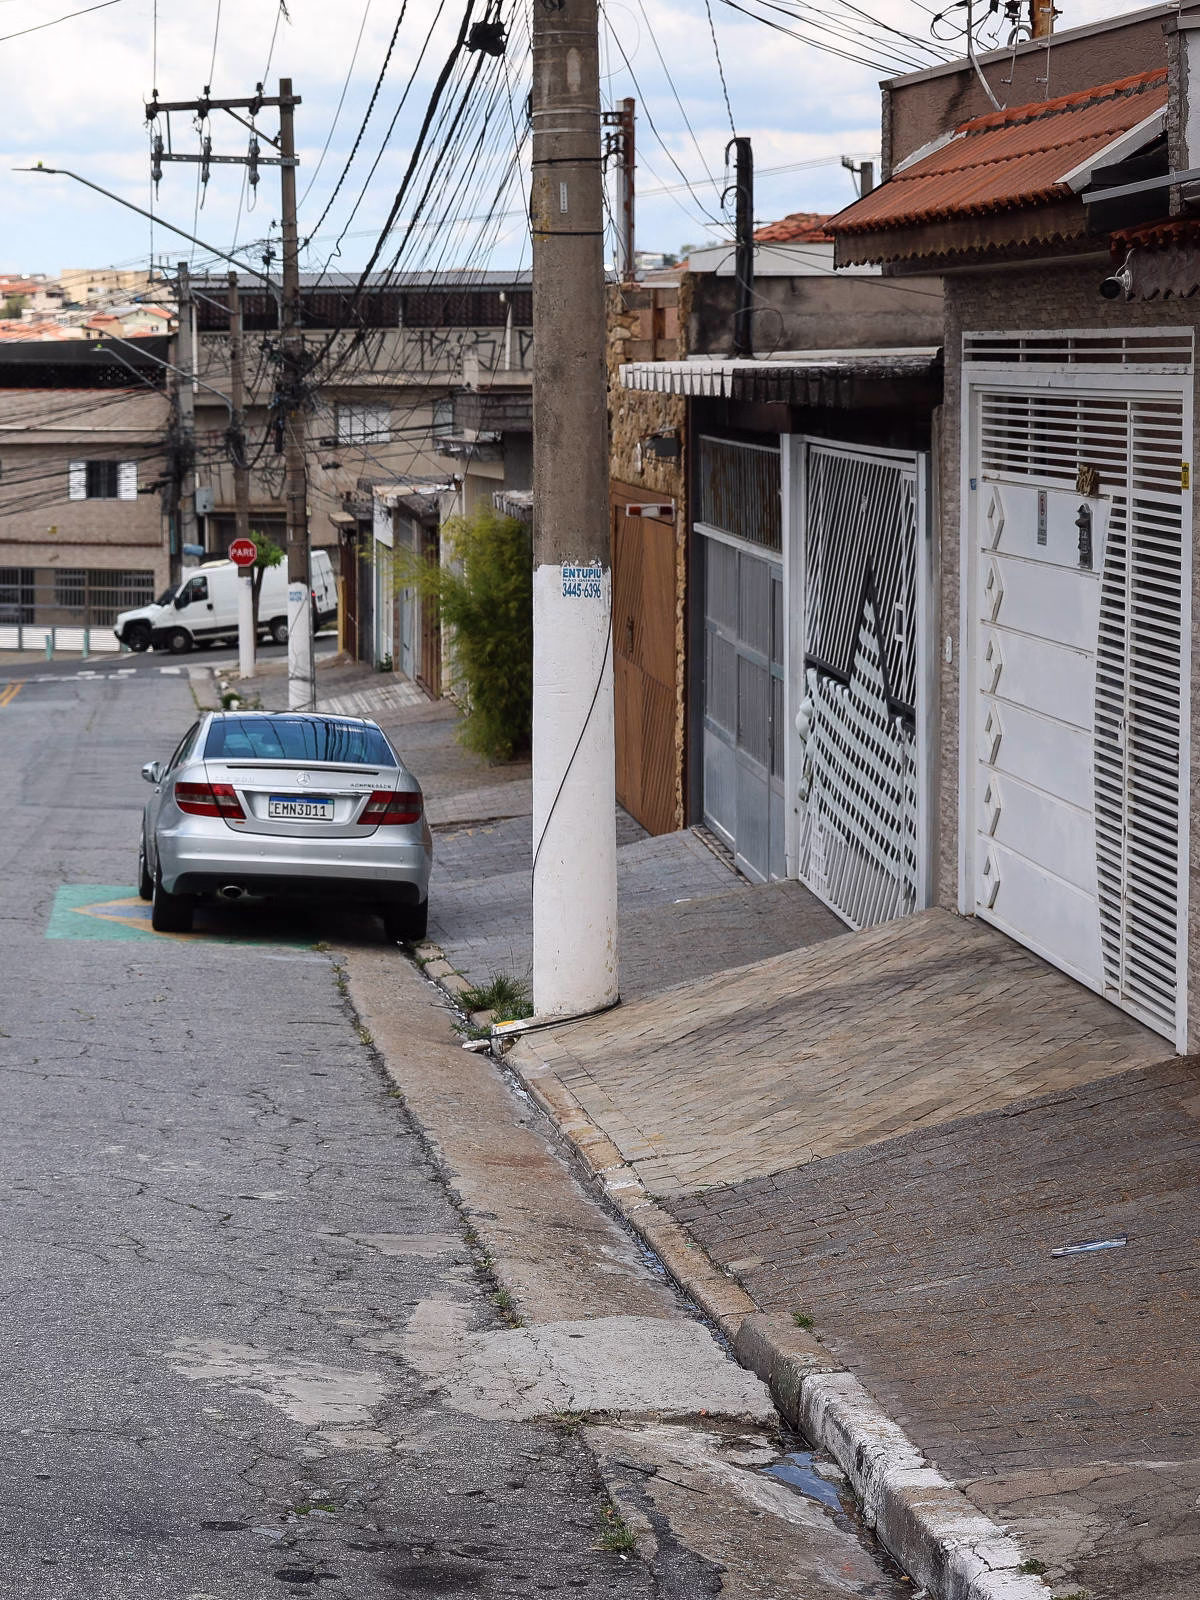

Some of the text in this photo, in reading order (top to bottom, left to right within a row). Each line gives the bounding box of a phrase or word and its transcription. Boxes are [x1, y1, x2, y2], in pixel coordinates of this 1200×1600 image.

[231, 547, 254, 557] PARE
[562, 568, 601, 579] ENTUPIU
[562, 583, 601, 598] 3445-6396
[274, 802, 327, 817] EMN3D11
